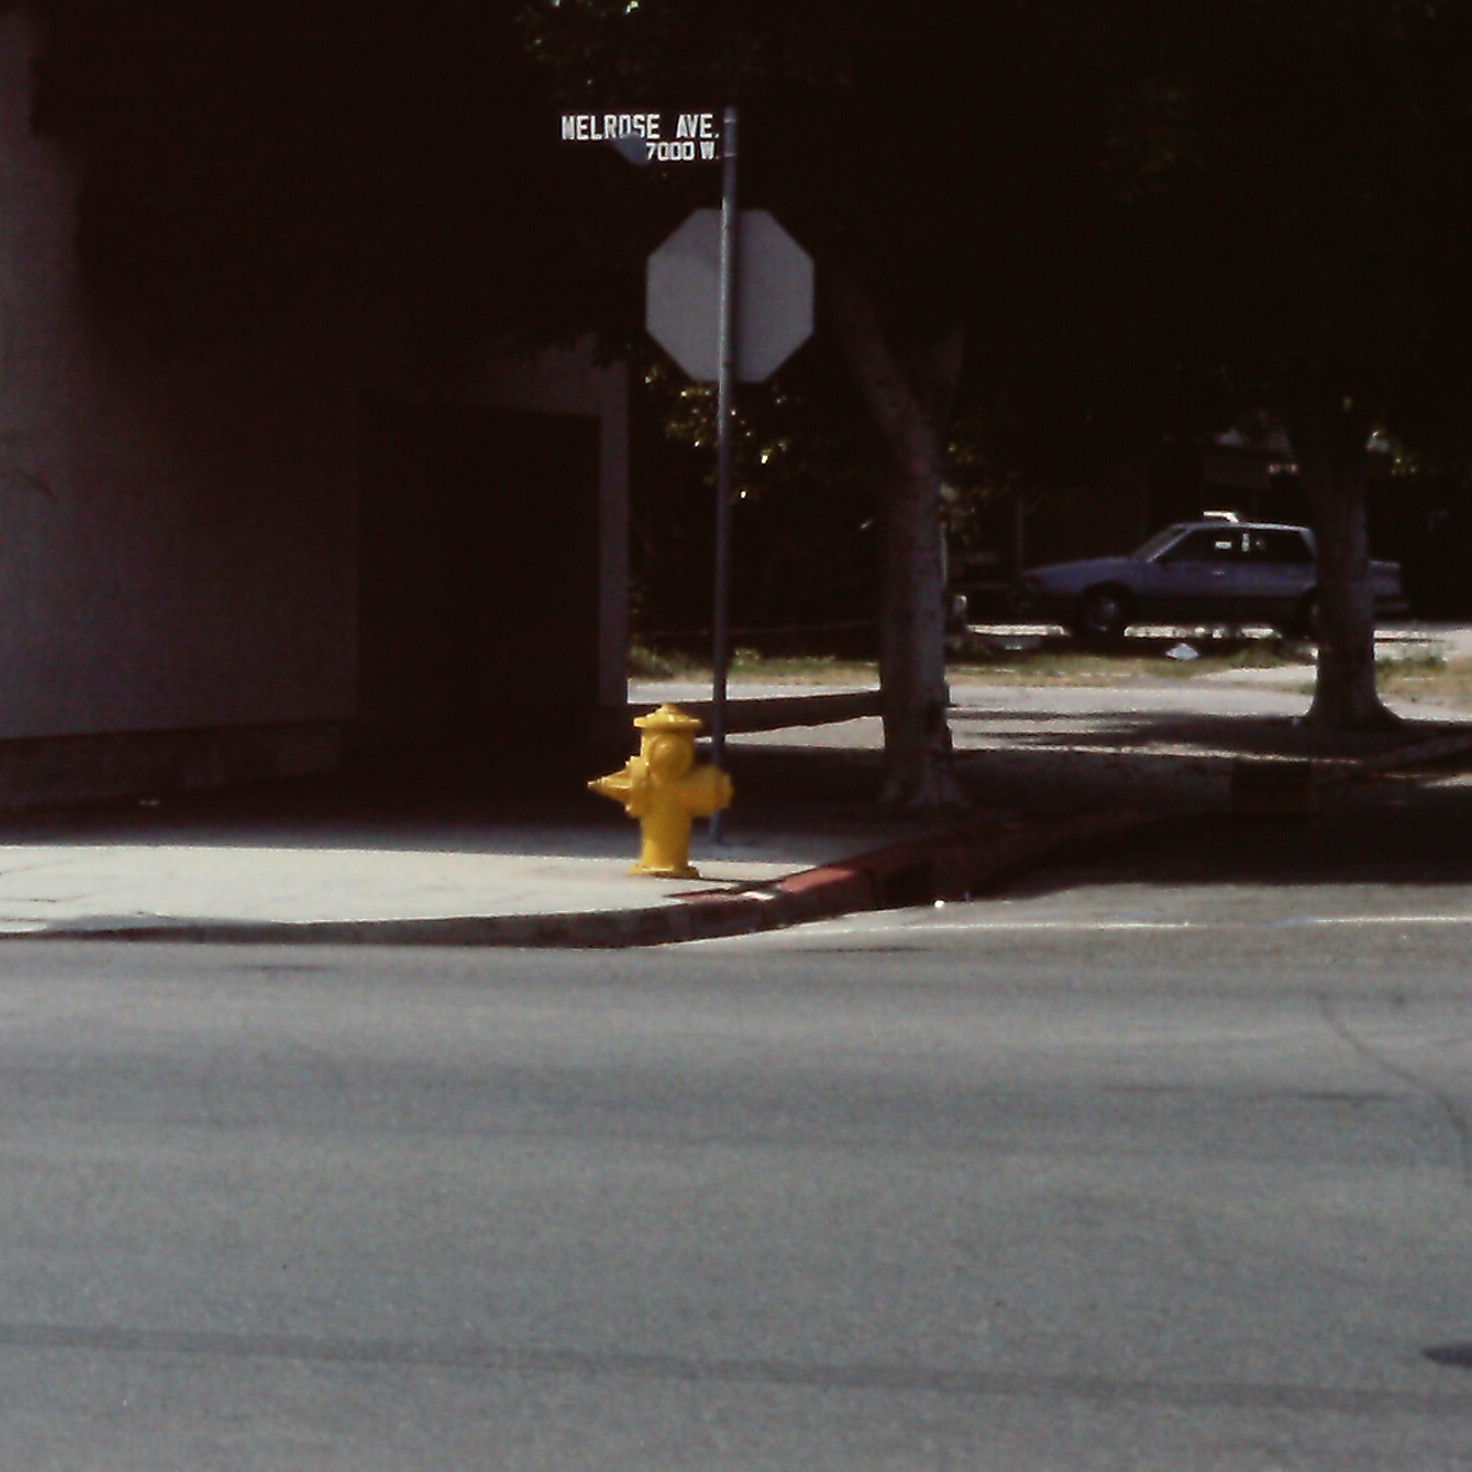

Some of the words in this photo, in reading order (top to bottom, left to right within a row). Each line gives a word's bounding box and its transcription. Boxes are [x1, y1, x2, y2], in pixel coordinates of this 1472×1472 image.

[561, 114, 660, 140] MELROSE
[676, 114, 719, 139] AVE.
[645, 141, 694, 161] 7000
